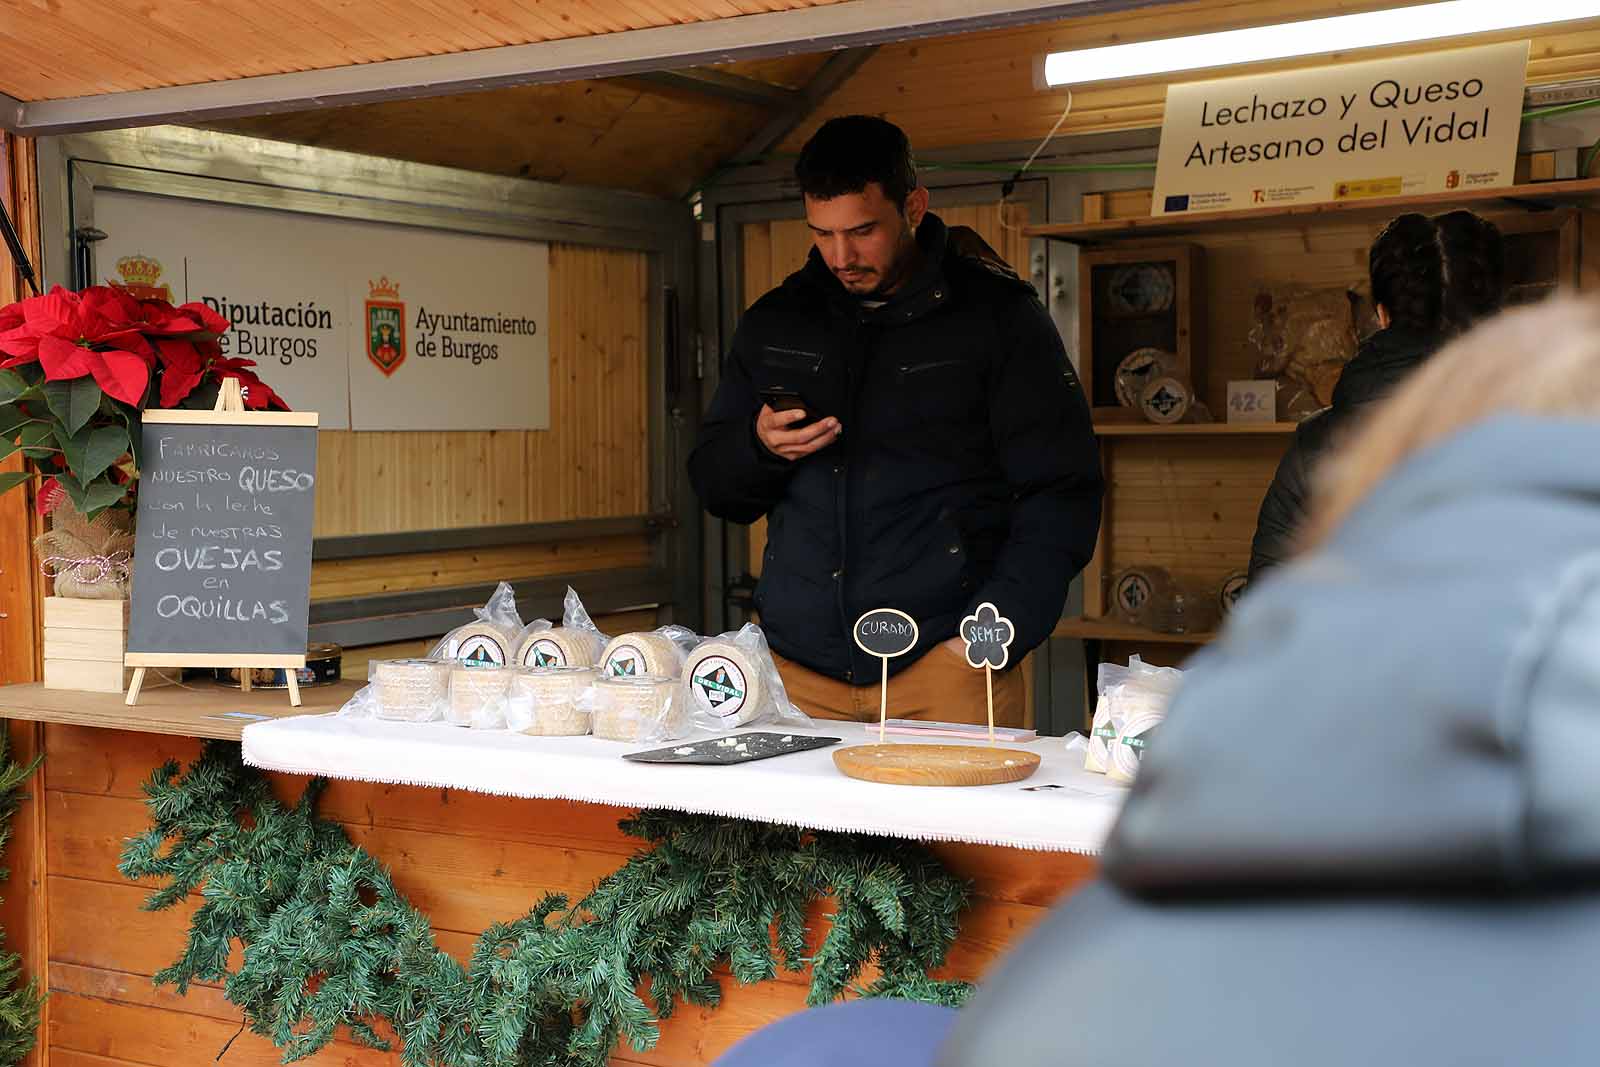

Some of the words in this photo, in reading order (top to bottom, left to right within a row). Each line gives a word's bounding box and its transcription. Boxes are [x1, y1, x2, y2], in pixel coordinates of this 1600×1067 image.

[1201, 95, 1327, 127] Lechazo
[1339, 93, 1357, 120] y
[1369, 77, 1484, 108] Queso
[1184, 137, 1325, 167] Artesano
[1337, 120, 1388, 153] del
[1402, 108, 1490, 145] Vidal
[415, 306, 537, 337] Ayuntamiento
[237, 329, 318, 365] Burgos
[415, 335, 437, 358] de
[441, 336, 499, 365] Burgos
[238, 466, 315, 493] QUESO
[155, 547, 284, 572] OVEJAS
[202, 575, 230, 590] en
[861, 620, 913, 637] CURADO
[970, 625, 1005, 644] SEMI
[697, 677, 713, 687] DEL
[716, 684, 740, 697] VIDAL
